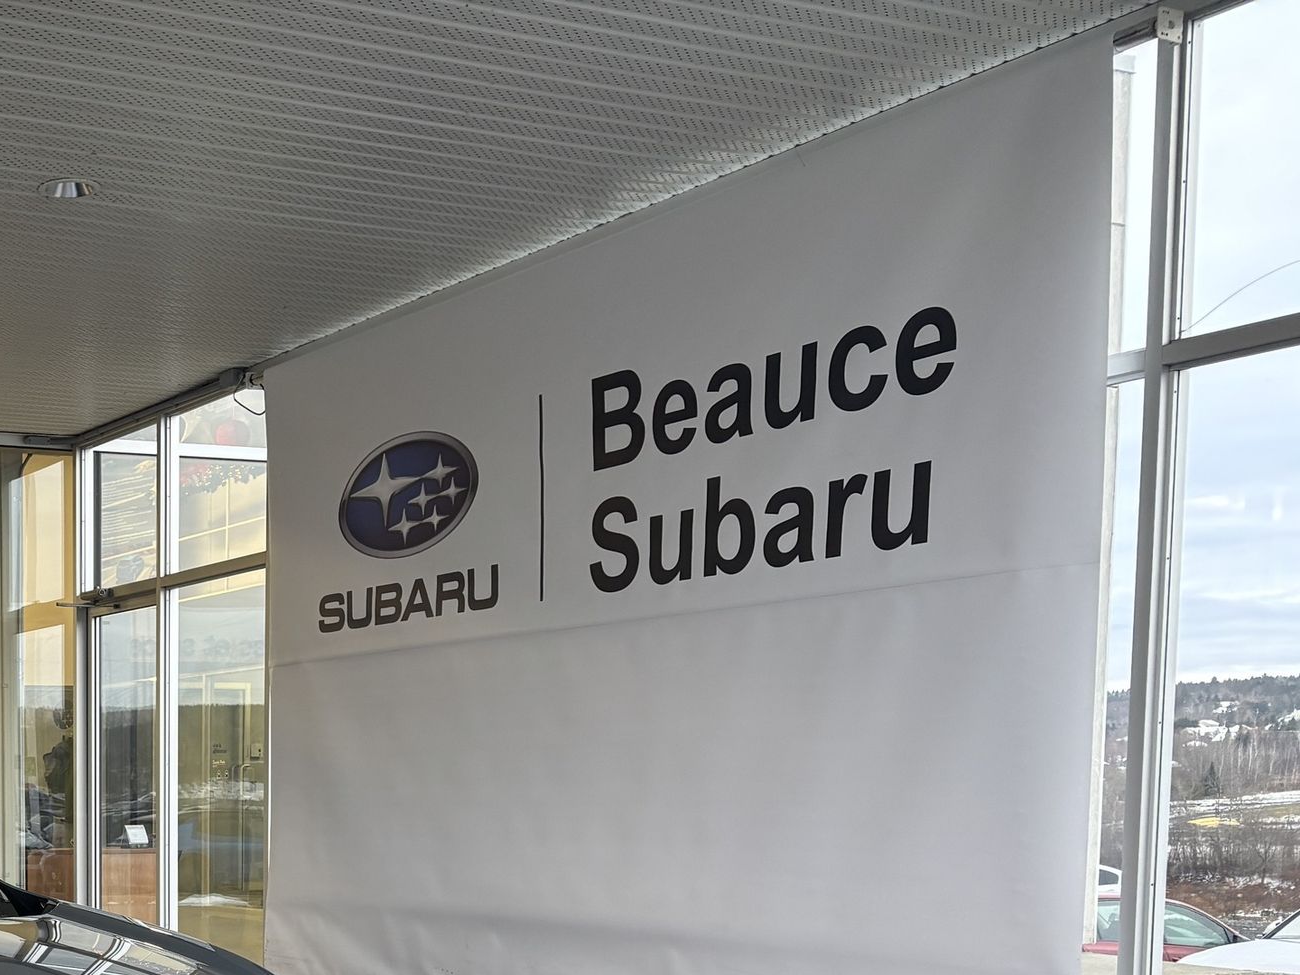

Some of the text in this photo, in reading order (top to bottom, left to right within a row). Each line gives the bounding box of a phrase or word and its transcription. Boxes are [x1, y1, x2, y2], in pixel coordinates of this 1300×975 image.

[591, 306, 957, 472] Beauce
[589, 460, 932, 593] Subaru
[318, 564, 499, 633] SUBARU
